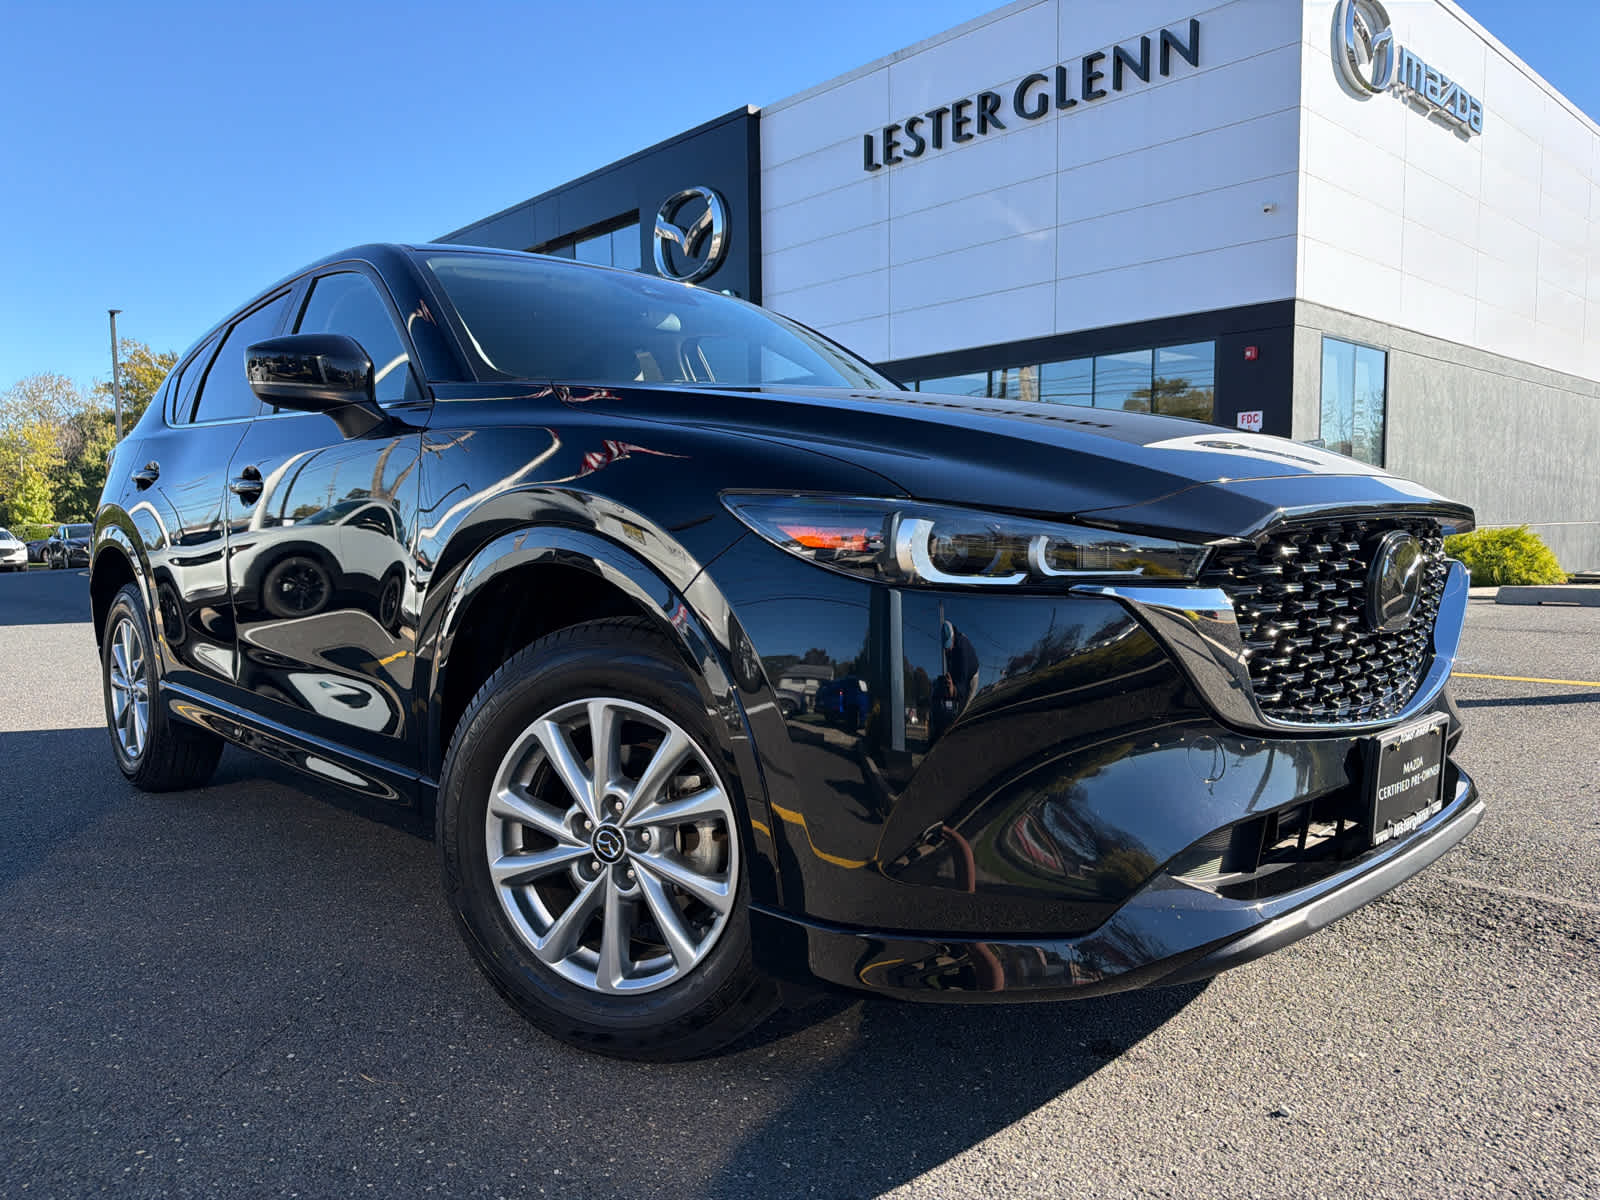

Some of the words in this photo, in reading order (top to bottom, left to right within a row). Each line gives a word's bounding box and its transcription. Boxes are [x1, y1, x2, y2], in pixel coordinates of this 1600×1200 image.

[864, 91, 1007, 172] LESTER
[1013, 18, 1200, 121] GLENN
[1241, 413, 1260, 424] FDC
[1403, 755, 1424, 774] MAZDA
[1378, 779, 1410, 800] CERTIFIED
